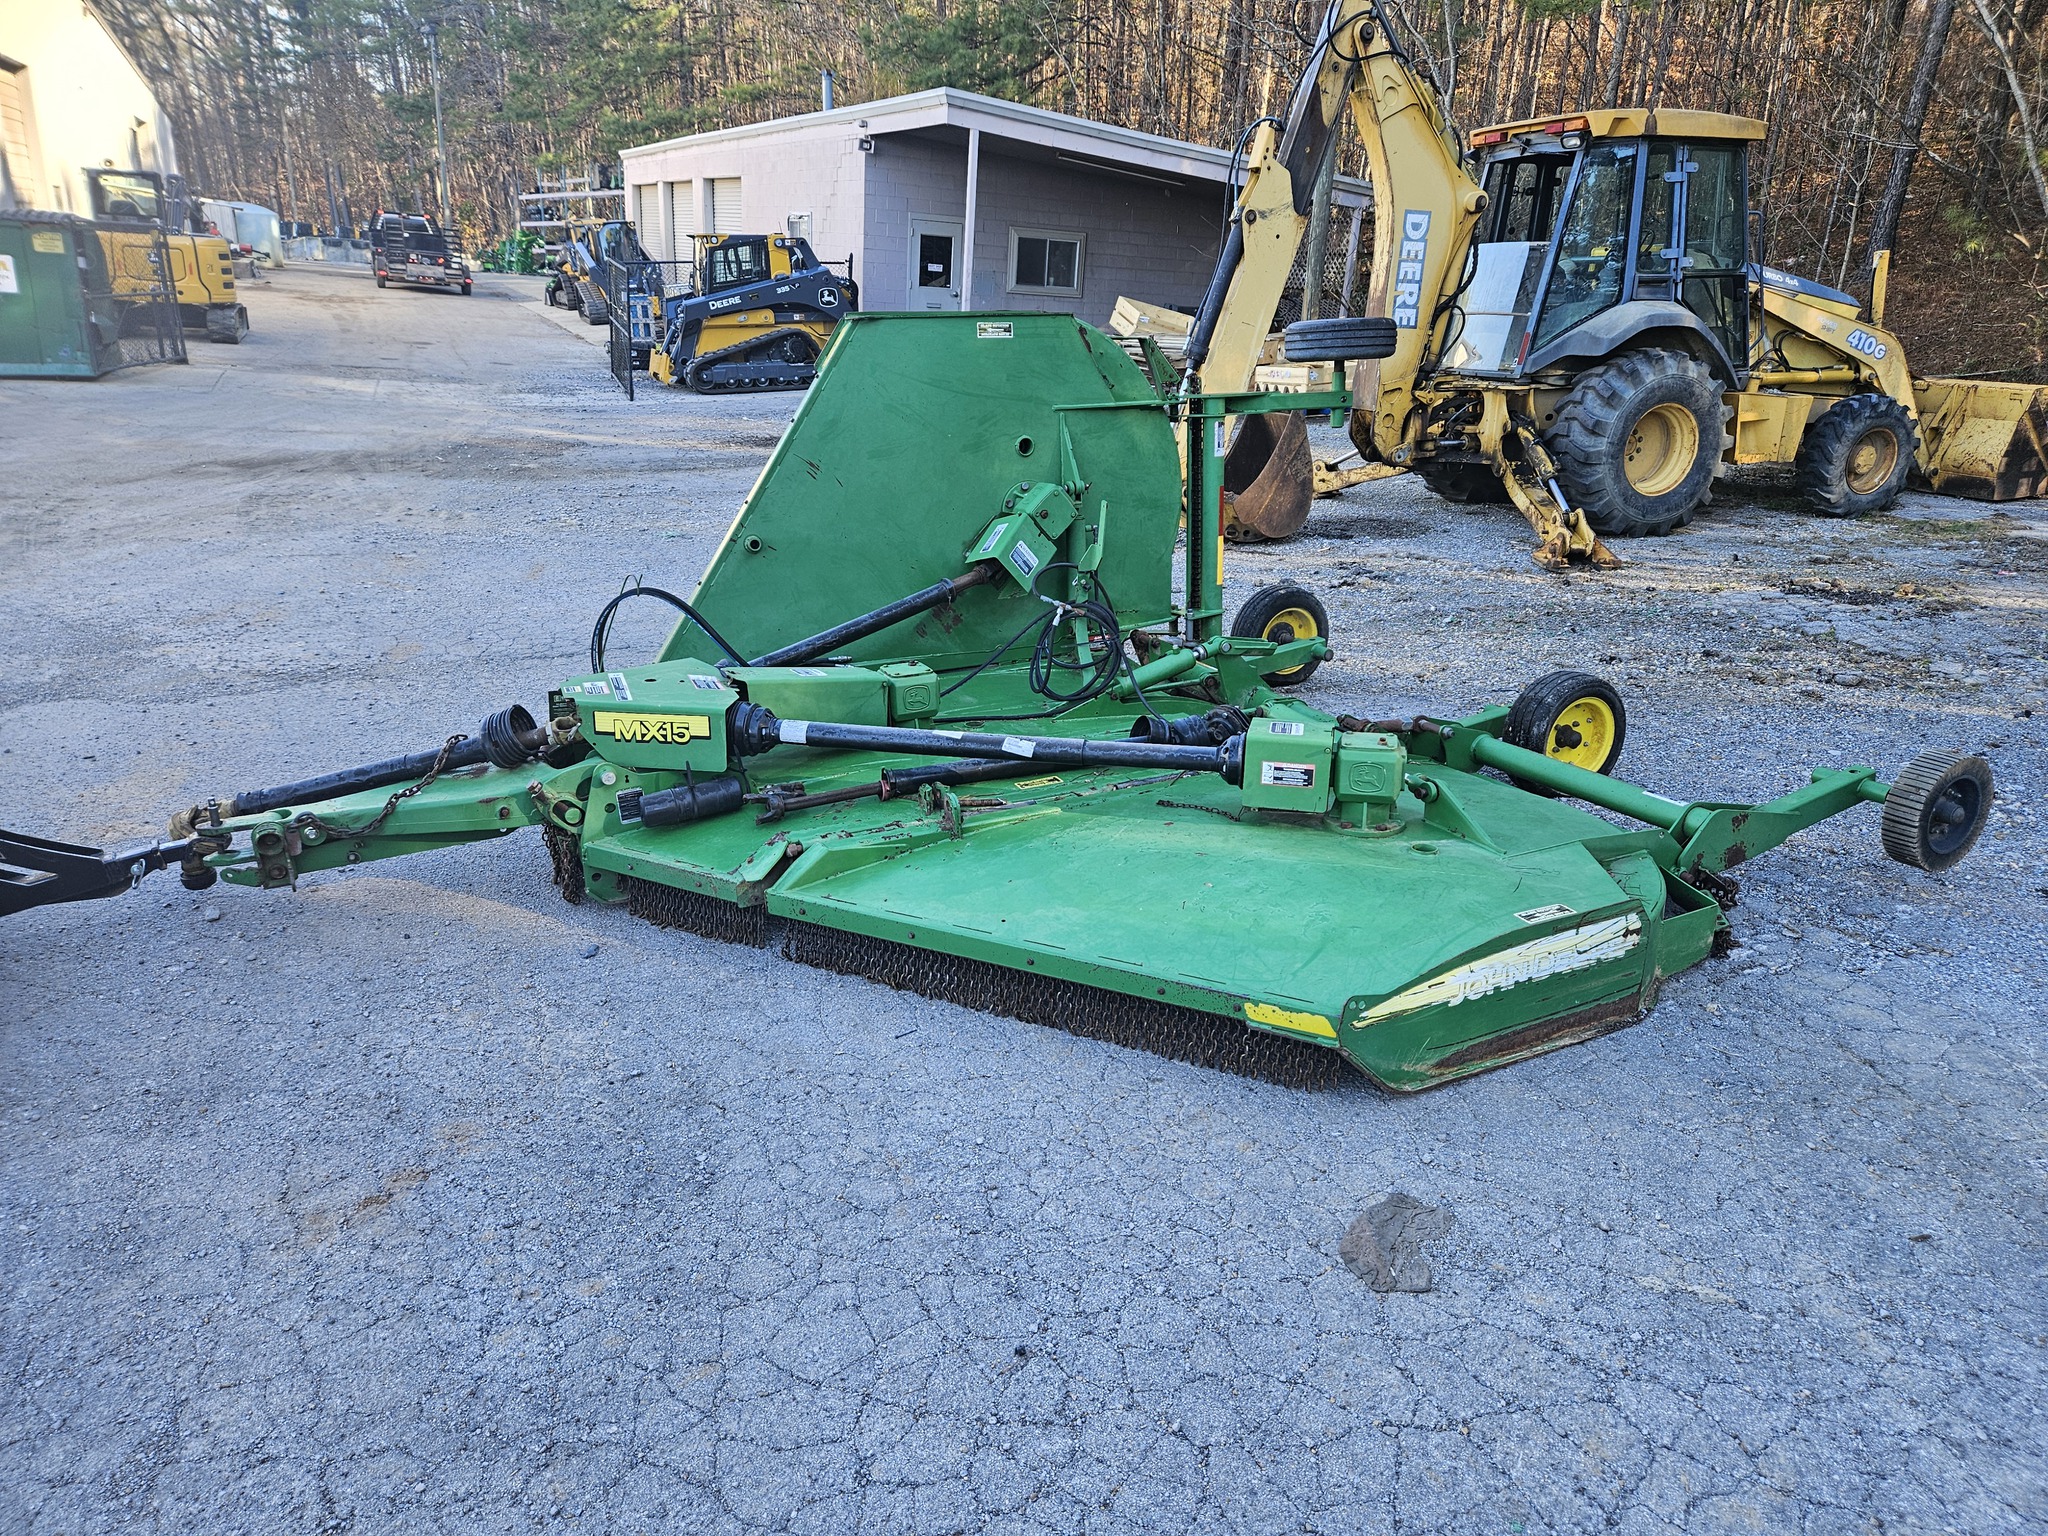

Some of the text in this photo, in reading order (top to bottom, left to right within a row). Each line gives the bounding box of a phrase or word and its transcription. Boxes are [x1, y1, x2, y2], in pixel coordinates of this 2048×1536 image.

[1394, 212, 1429, 327] DEERE
[1762, 269, 1784, 283] URBO
[708, 295, 742, 310] DEERE
[1846, 329, 1887, 359] 410G
